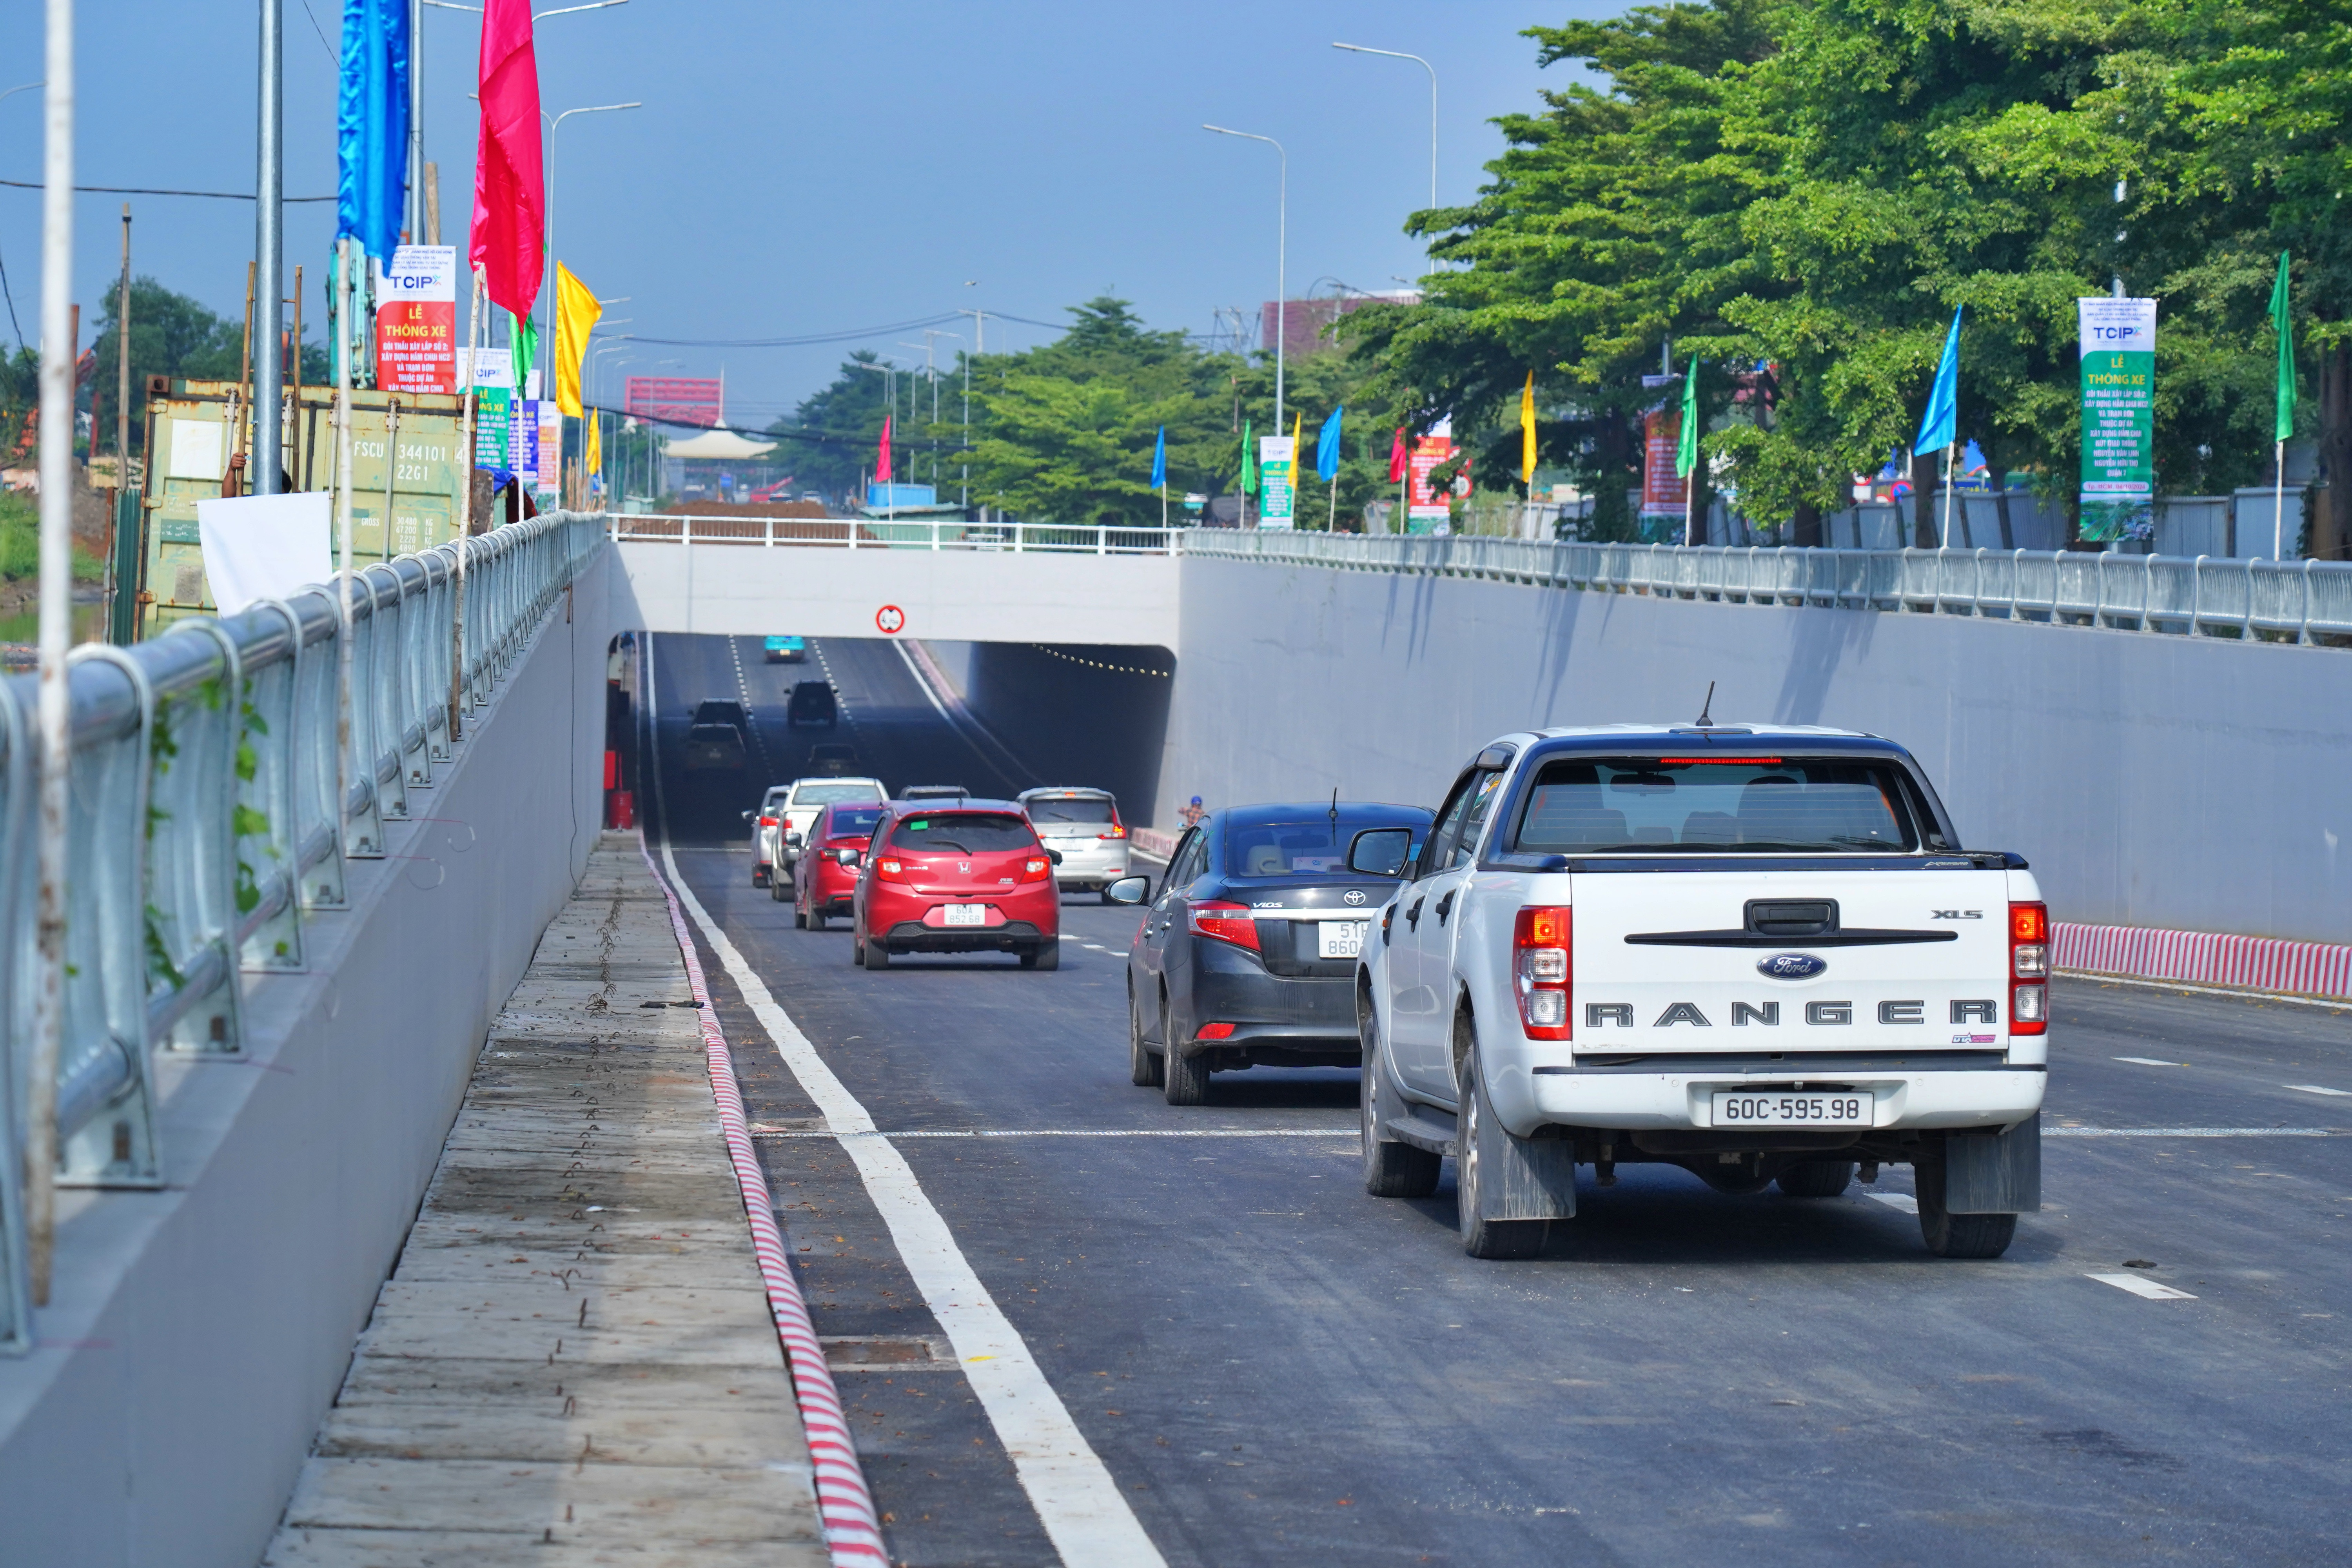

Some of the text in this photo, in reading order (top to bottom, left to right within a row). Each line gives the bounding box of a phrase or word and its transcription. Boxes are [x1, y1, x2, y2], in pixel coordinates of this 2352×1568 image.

[390, 276, 433, 288] TCIP
[409, 304, 422, 319] LỄ
[385, 323, 447, 337] THÔNG XE
[2094, 327, 2134, 339] TCIP
[383, 341, 393, 350] GÓI
[394, 340, 408, 350] THẦU
[410, 341, 420, 350] XÂY
[434, 341, 442, 351] SỐ
[381, 352, 392, 361] XÂY
[394, 352, 409, 362] DỰNG
[410, 351, 423, 361] HẦM
[397, 362, 404, 371] VÀ
[405, 364, 420, 373] TRẠM
[476, 369, 495, 377] CIP
[398, 373, 434, 383] THUỘC DỰ ÁN
[2088, 372, 2145, 385] THÔNG XE
[430, 385, 444, 393] CHUI
[354, 441, 384, 458] FSCU
[399, 444, 445, 462] 344101
[397, 464, 428, 481] 22G1
[361, 516, 433, 527] GROSS 30.480 KG
[425, 527, 432, 535] LB
[425, 537, 432, 545] KG
[1931, 910, 1983, 919] XLS
[1774, 957, 1811, 973] Ford
[1586, 1000, 1996, 1027] RANGER
[1727, 1099, 1859, 1119] 60C-595.98
